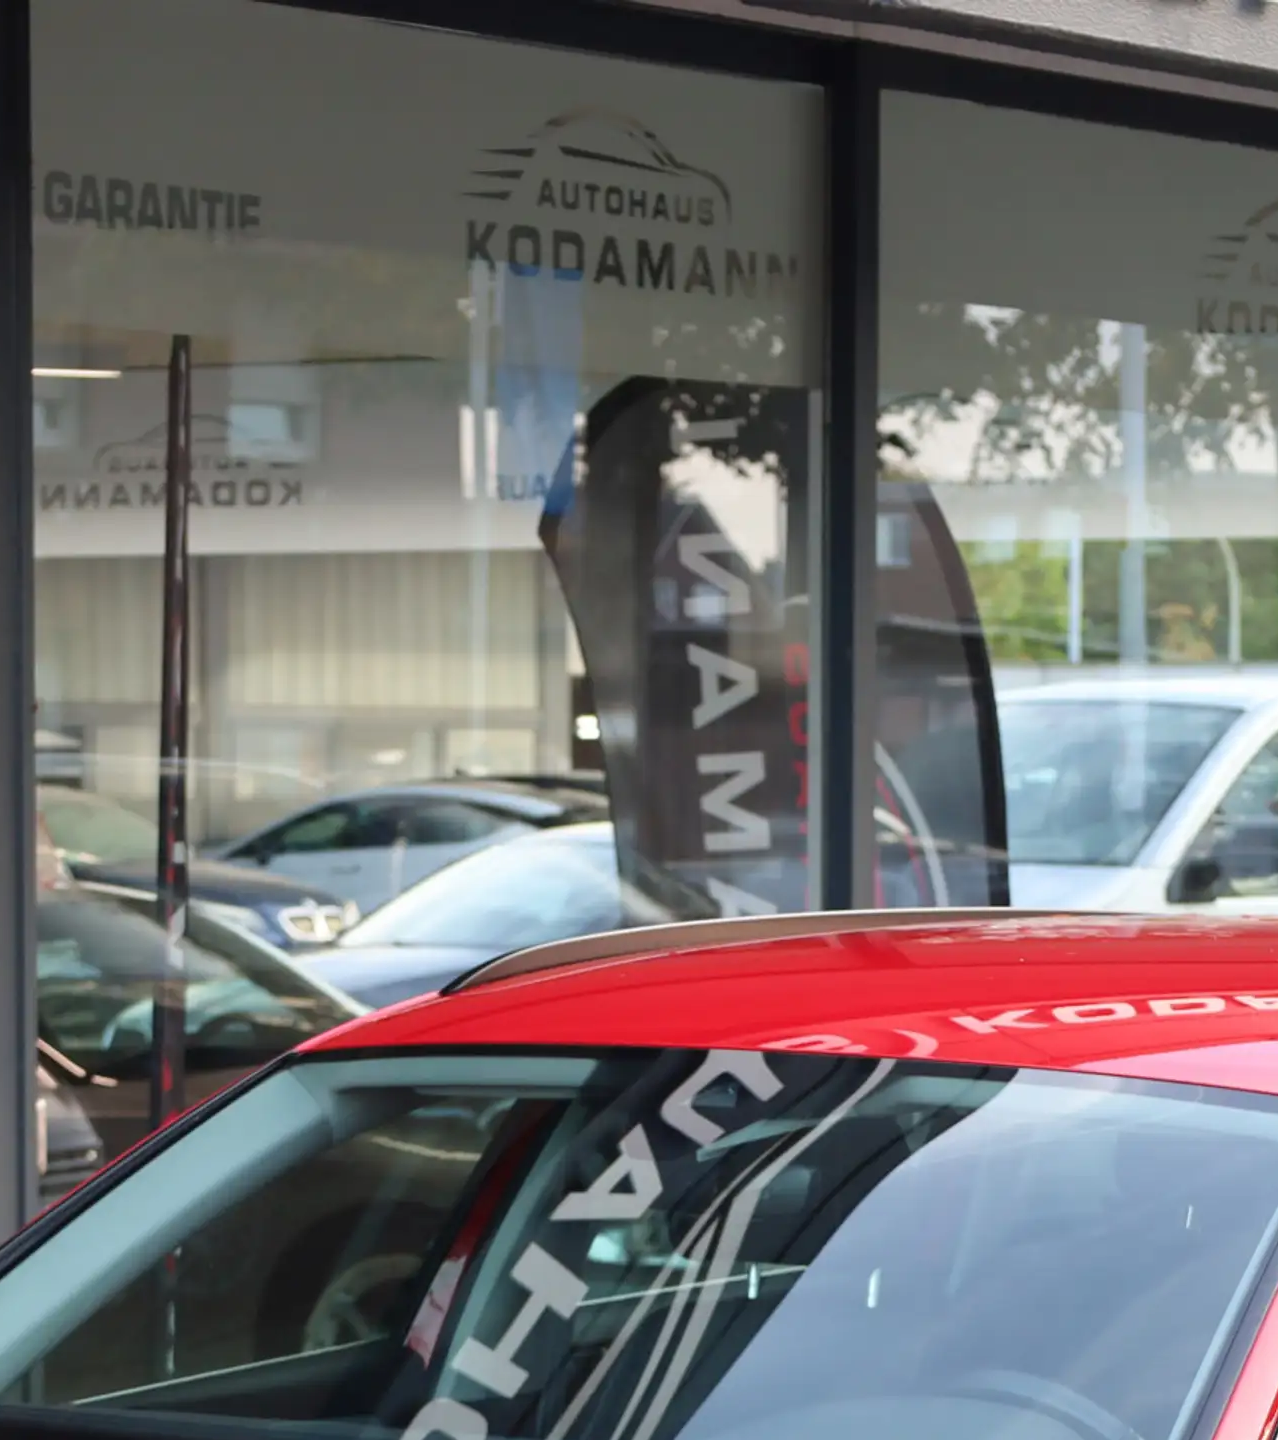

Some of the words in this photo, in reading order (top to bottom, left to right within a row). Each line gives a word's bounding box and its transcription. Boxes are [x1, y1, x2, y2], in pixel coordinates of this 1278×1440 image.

[43, 170, 263, 231] GARANTIE
[536, 178, 716, 228] AUTOHAUS
[466, 219, 799, 300] KODAMANN
